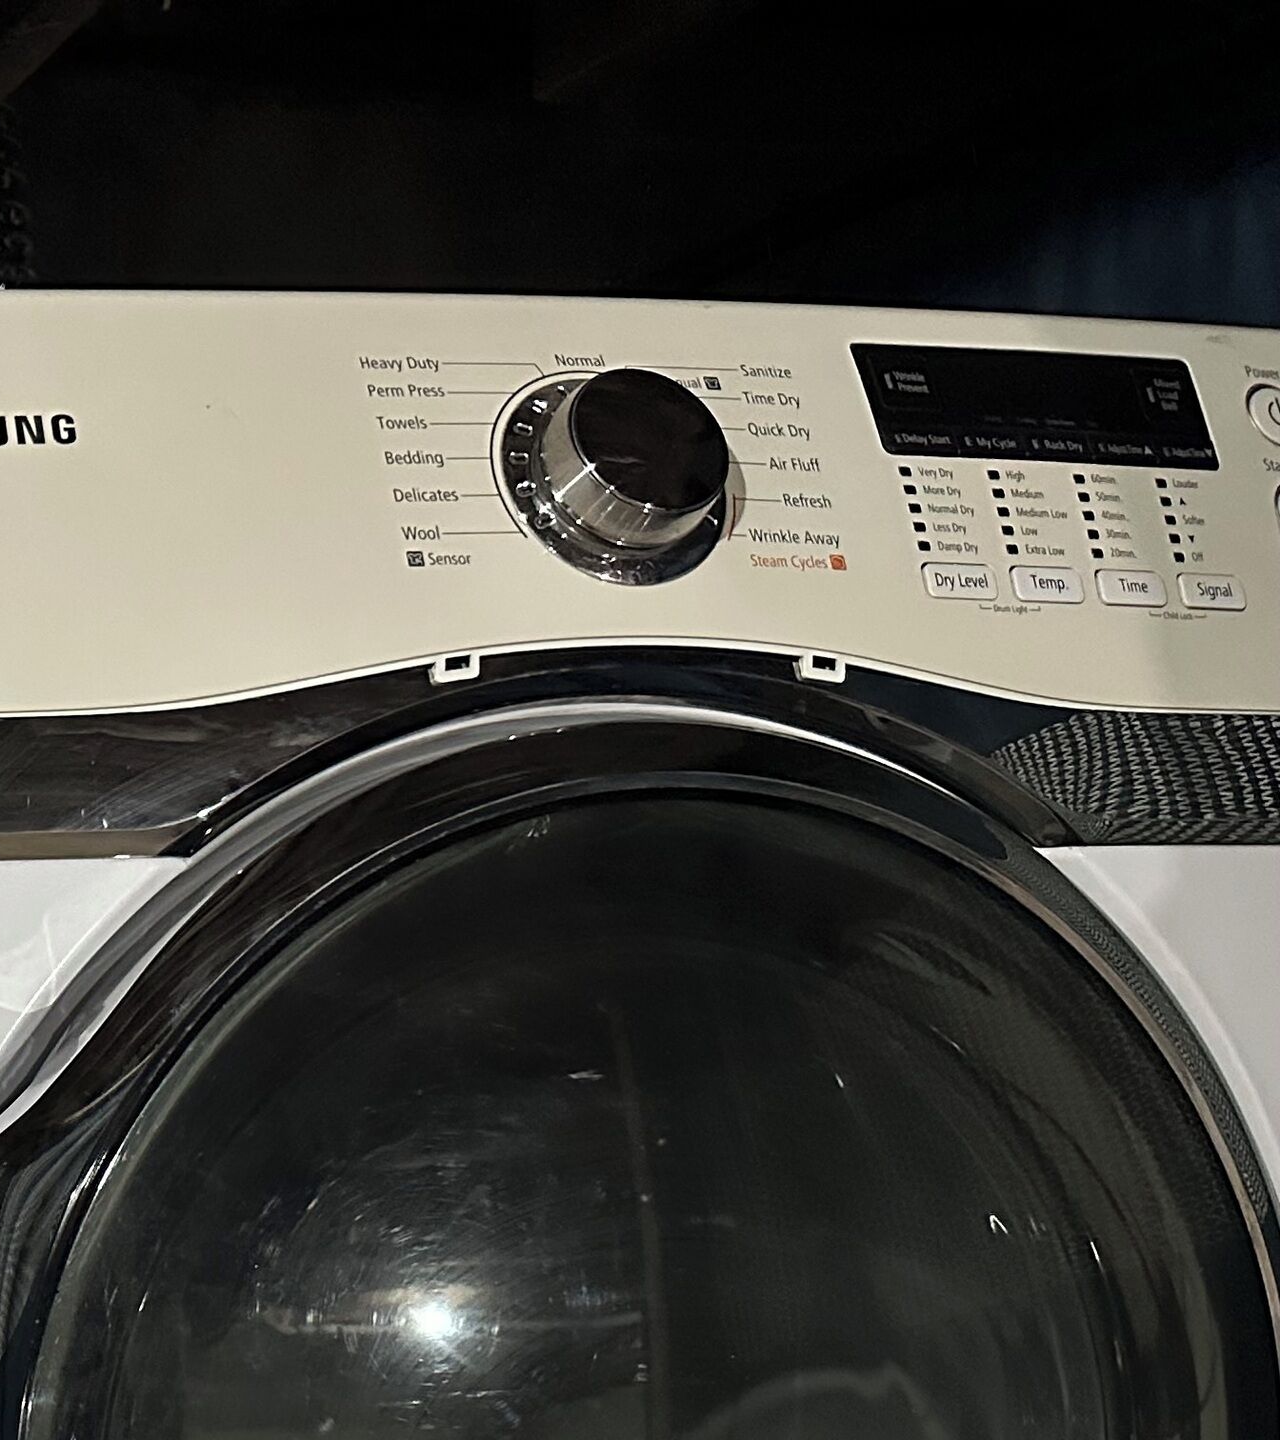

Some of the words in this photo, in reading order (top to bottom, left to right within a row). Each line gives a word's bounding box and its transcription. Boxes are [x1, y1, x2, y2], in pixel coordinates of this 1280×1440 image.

[359, 356, 402, 372] Heavy
[406, 357, 439, 372] Duty
[555, 353, 605, 367] Normal
[740, 364, 792, 379] Sanitize
[367, 384, 404, 397] Perm
[408, 385, 445, 397] Press
[742, 392, 775, 405] Time
[777, 393, 800, 409] Dry
[376, 415, 428, 429] Towels
[747, 422, 785, 438] Quick
[788, 424, 810, 441] Dry
[384, 451, 444, 468] Bedding
[770, 457, 787, 470] Air
[791, 457, 820, 472] Fluff
[918, 467, 937, 479] Very
[940, 467, 953, 480] Dry
[1005, 470, 1025, 483] High
[393, 488, 459, 502] Delicates
[923, 485, 945, 495] More
[947, 486, 961, 498] Dry
[1011, 490, 1044, 499] Medium
[783, 493, 832, 508] Refresh
[960, 506, 974, 517] Dry
[1050, 509, 1068, 519] Low
[401, 525, 440, 540] Wool
[933, 522, 951, 532] Less
[952, 523, 967, 535] Dry
[1021, 527, 1037, 536] Low
[748, 528, 800, 544] Wrinkle
[804, 531, 840, 549] Away
[937, 541, 962, 554] Damp
[964, 542, 978, 554] Dry
[1025, 545, 1047, 555] Extra
[1049, 546, 1065, 556] Low
[427, 553, 471, 566] Sensor
[750, 554, 788, 567] Steam
[790, 555, 828, 571] Cycles
[1192, 552, 1203, 562] Off
[934, 572, 955, 591] Dry
[958, 573, 989, 588] Level
[1030, 574, 1069, 593] Temp.
[1119, 578, 1149, 593] Time
[1197, 582, 1233, 600] Signal
